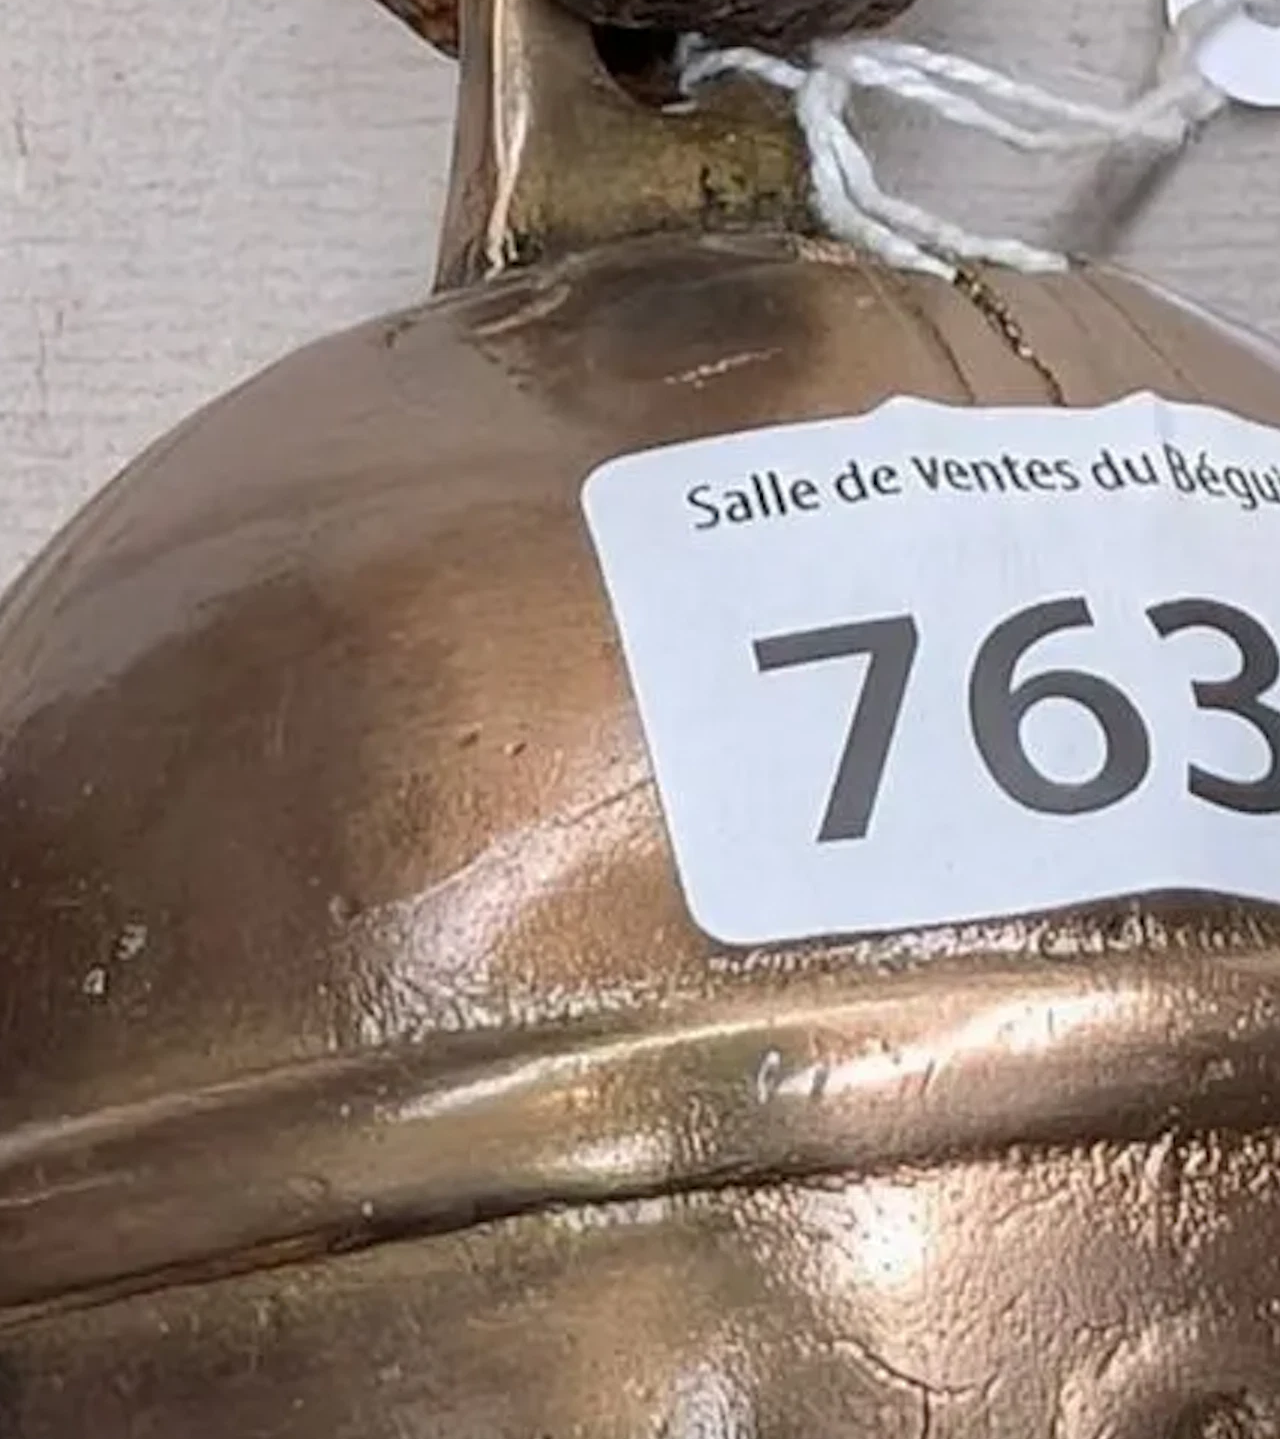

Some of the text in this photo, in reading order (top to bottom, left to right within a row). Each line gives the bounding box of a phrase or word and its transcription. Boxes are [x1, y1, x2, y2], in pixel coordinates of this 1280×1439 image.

[687, 468, 821, 530] Salle
[834, 459, 899, 507] de
[910, 452, 1080, 492] Ventes
[1090, 449, 1158, 490] du
